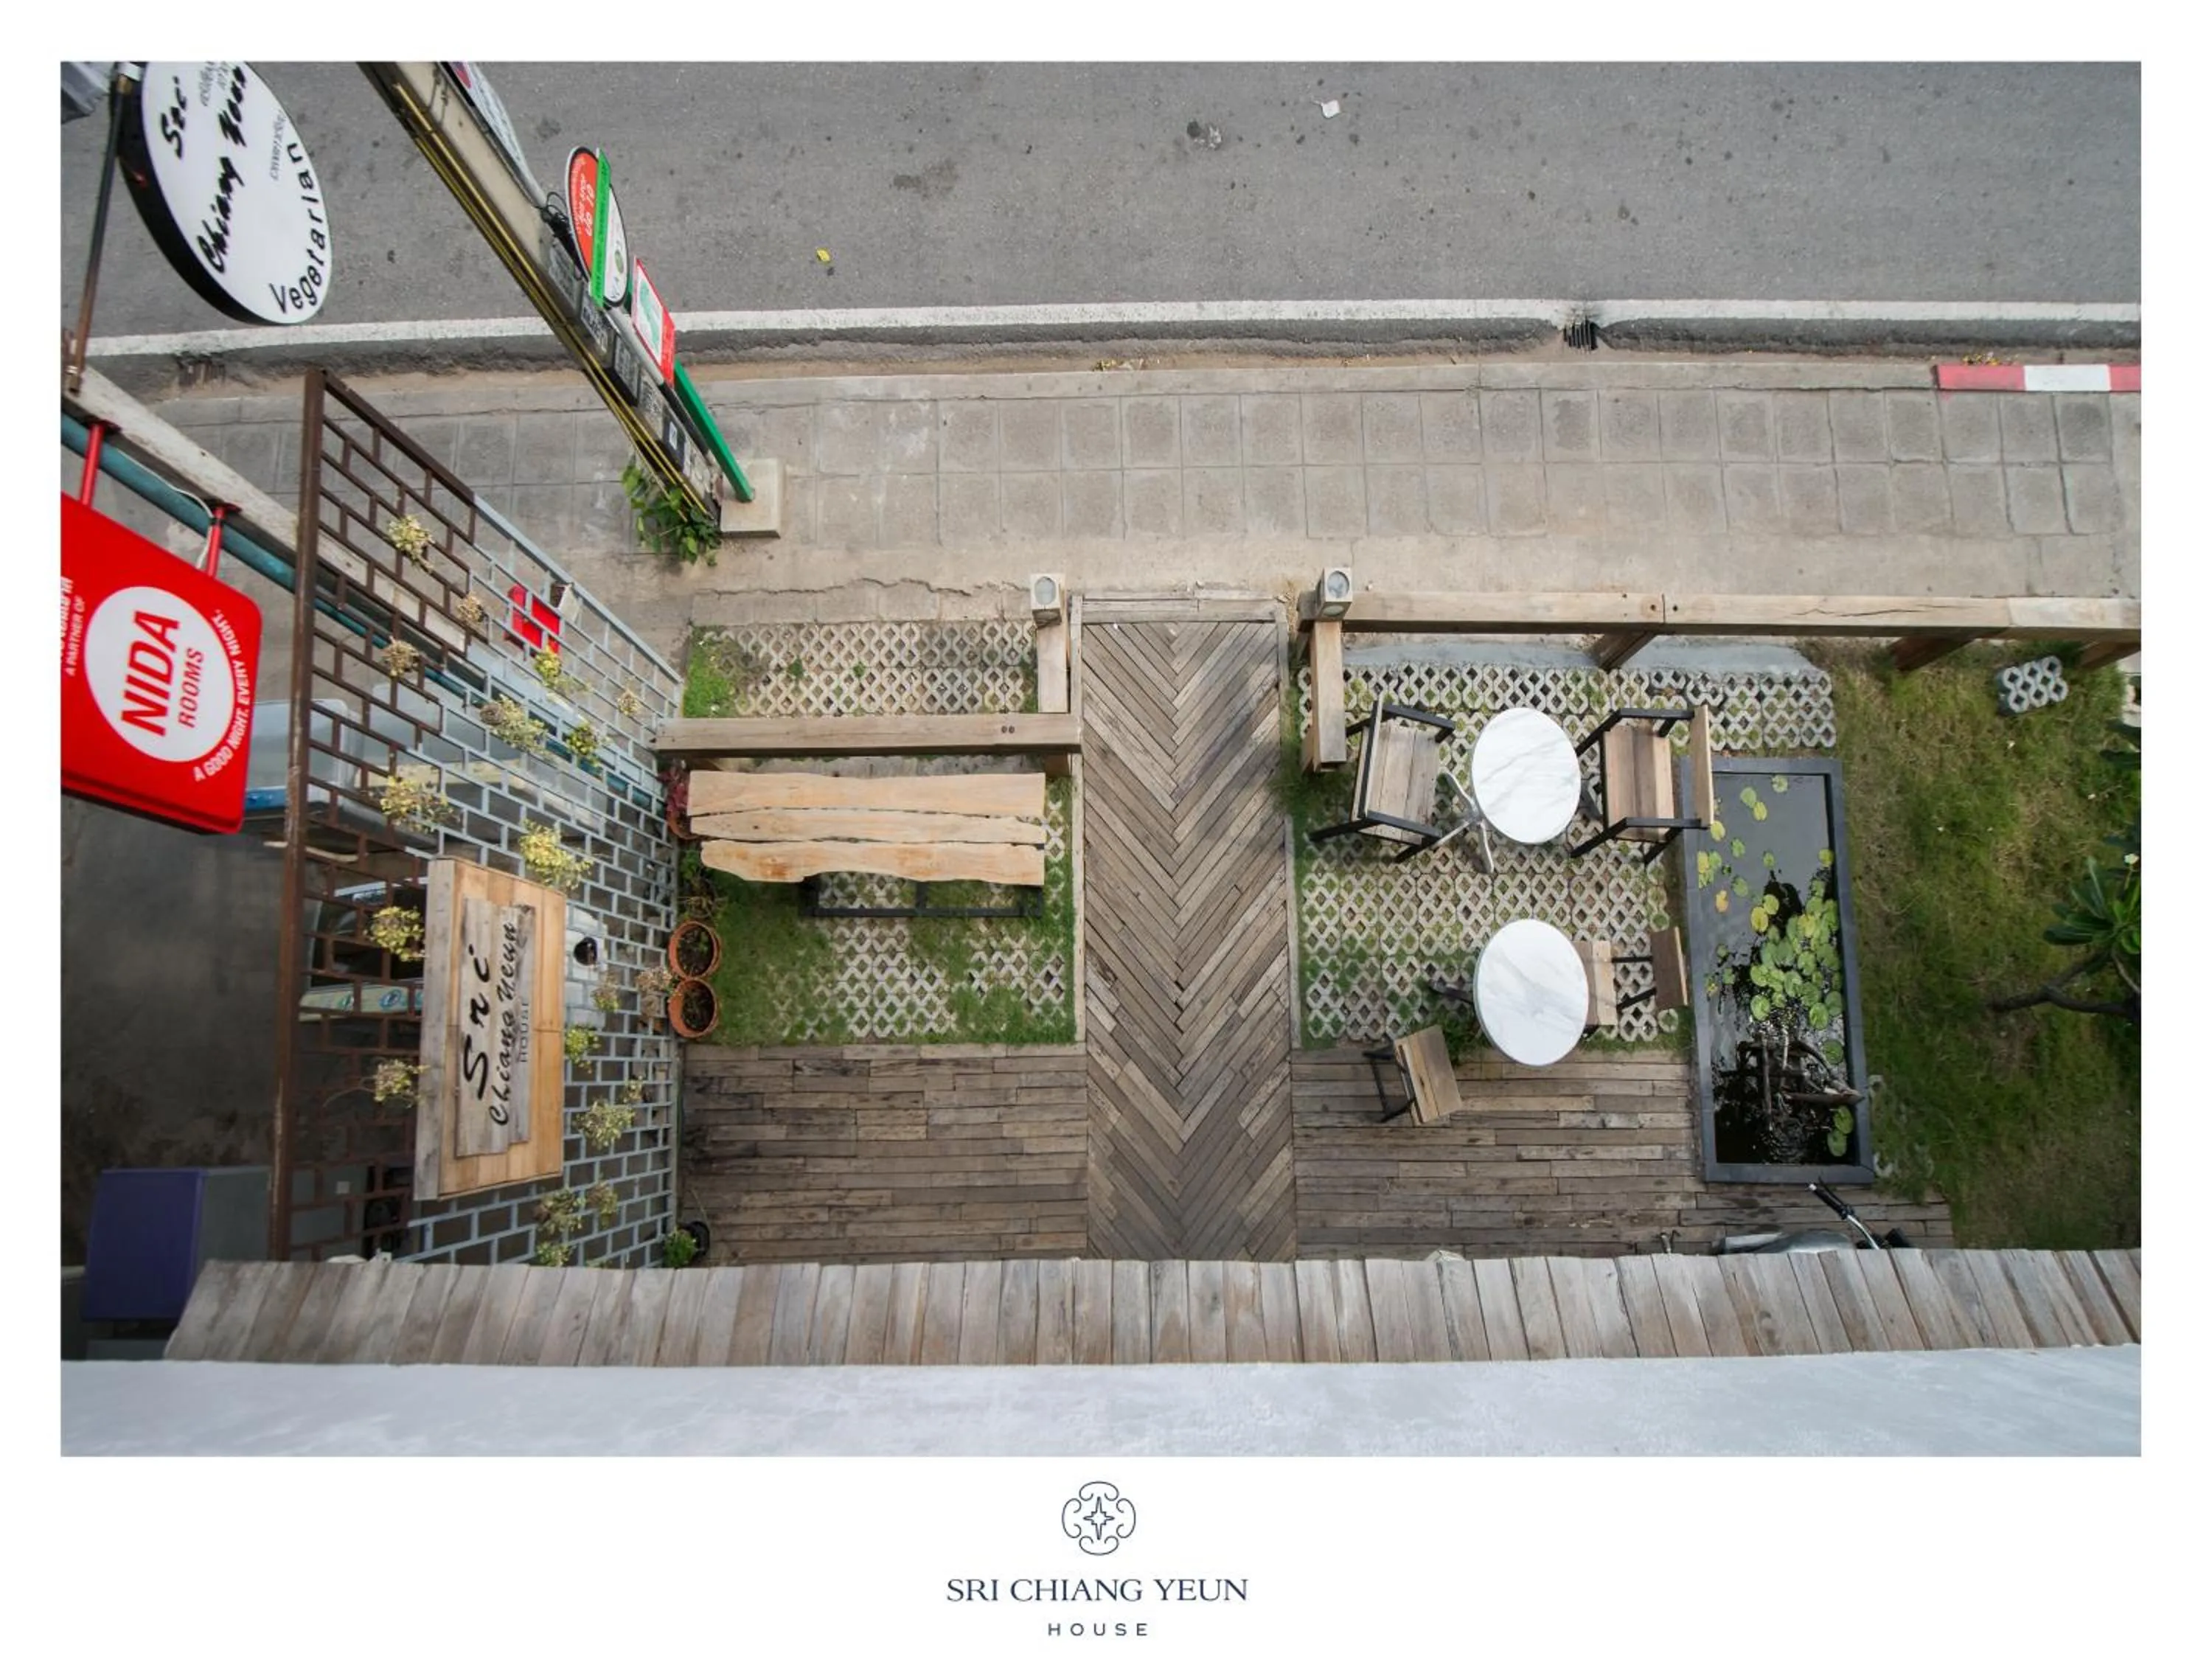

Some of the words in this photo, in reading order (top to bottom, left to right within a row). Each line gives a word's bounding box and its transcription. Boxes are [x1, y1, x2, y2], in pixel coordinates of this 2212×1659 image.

[270, 142, 327, 314] Vegetarian
[66, 613, 83, 666] PARTNER
[73, 594, 86, 613] OF
[120, 611, 180, 737] NIDA
[178, 647, 204, 728] ROOMS
[192, 765, 206, 782] A
[201, 746, 234, 776] GOOD
[232, 659, 251, 706] EVERY
[463, 944, 490, 1102] Sri
[489, 1010, 518, 1127] Chiang
